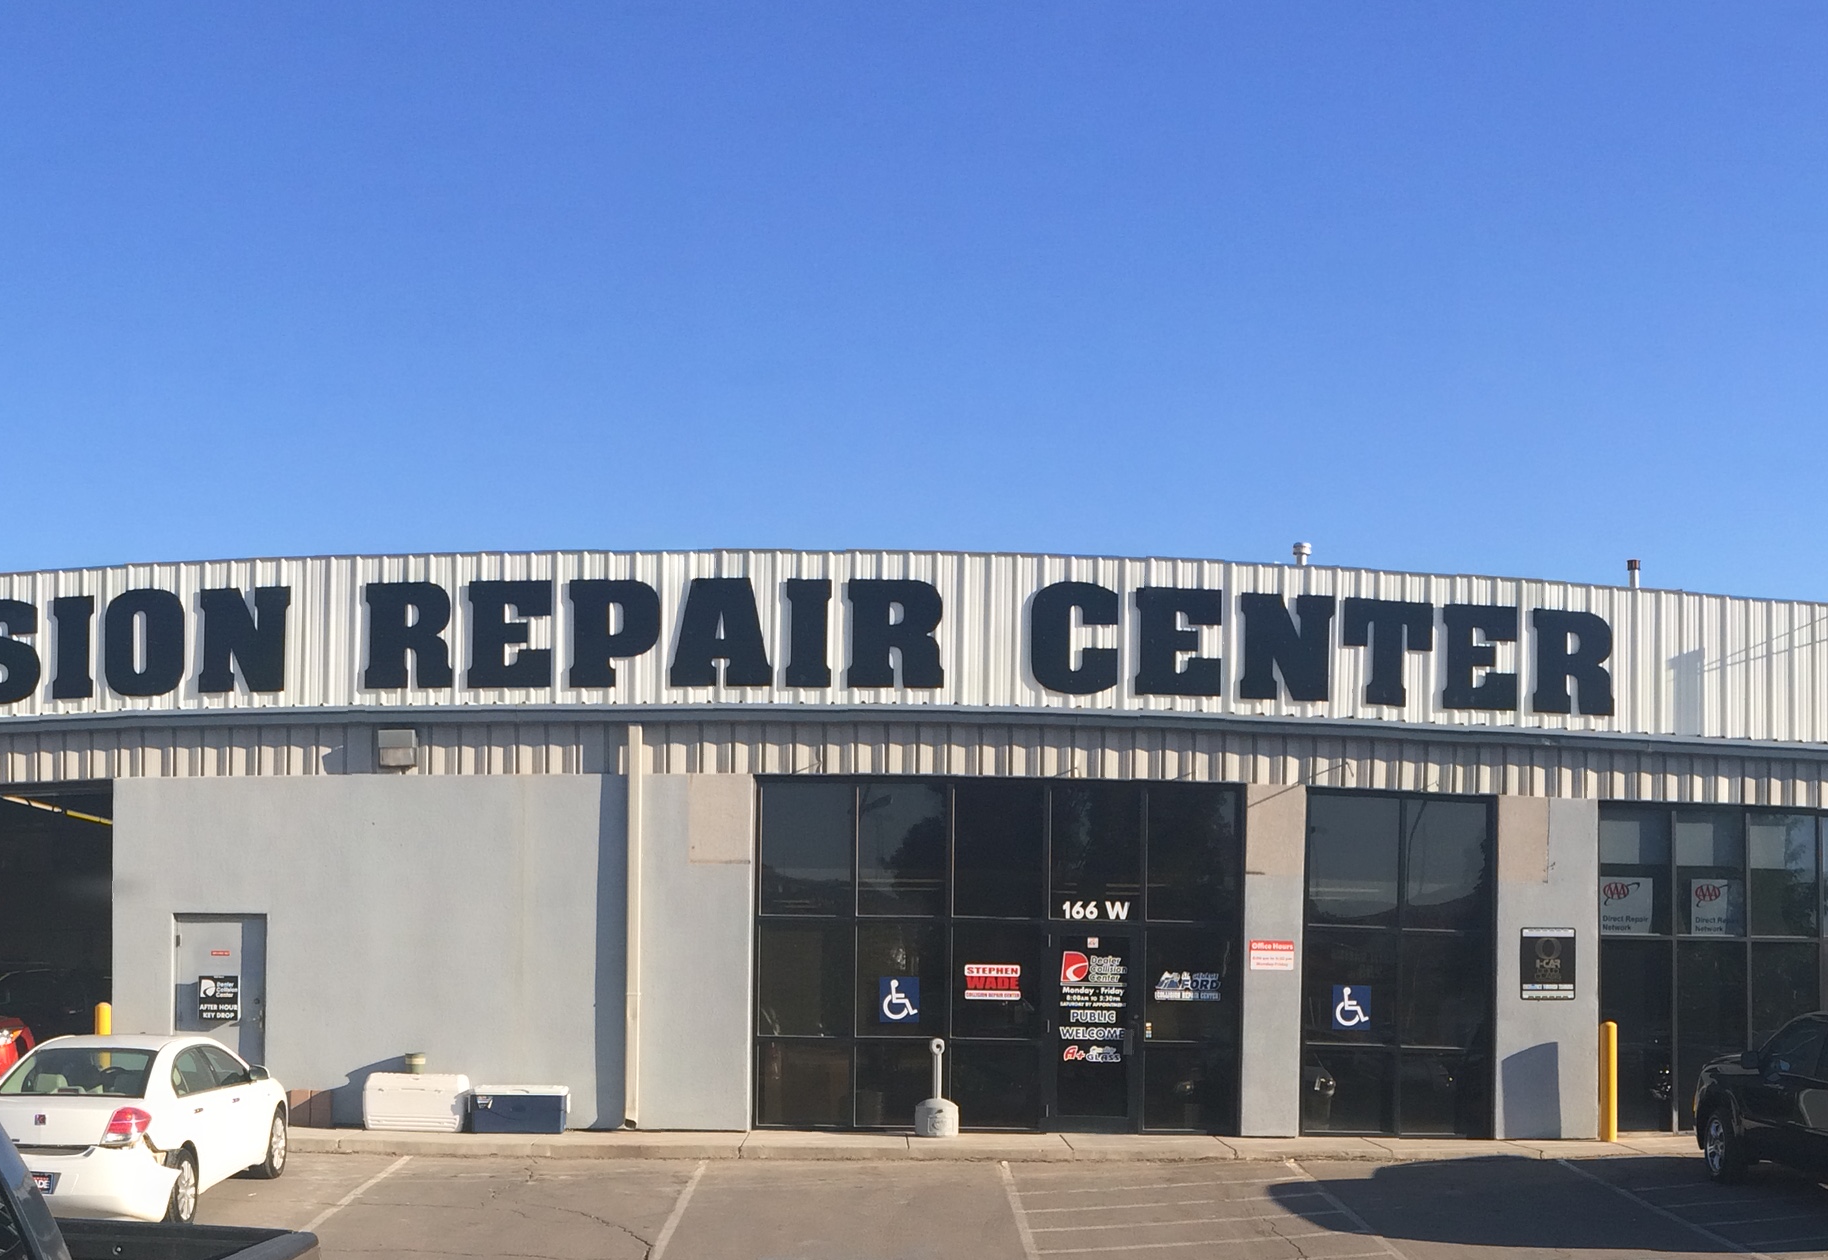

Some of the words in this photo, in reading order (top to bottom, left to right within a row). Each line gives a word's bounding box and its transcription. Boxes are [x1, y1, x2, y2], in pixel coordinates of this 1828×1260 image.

[364, 578, 944, 689] REPAIR
[1031, 581, 1615, 716] CENTER
[1062, 901, 1098, 920] 166
[1105, 901, 1131, 920] W
[1626, 915, 1648, 923] Repair
[1090, 955, 1121, 965] Dealer
[966, 967, 1018, 975] STEPHEN
[1089, 965, 1128, 974] Collision
[966, 976, 1020, 990] WADE
[1089, 973, 1121, 982] Center
[1180, 979, 1221, 991] FORD
[1062, 987, 1094, 996] Monday
[1100, 987, 1125, 996] Friday
[1070, 1010, 1116, 1023] PUBLIC
[1059, 1027, 1125, 1040] WELCOME
[1063, 1045, 1085, 1061] A+
